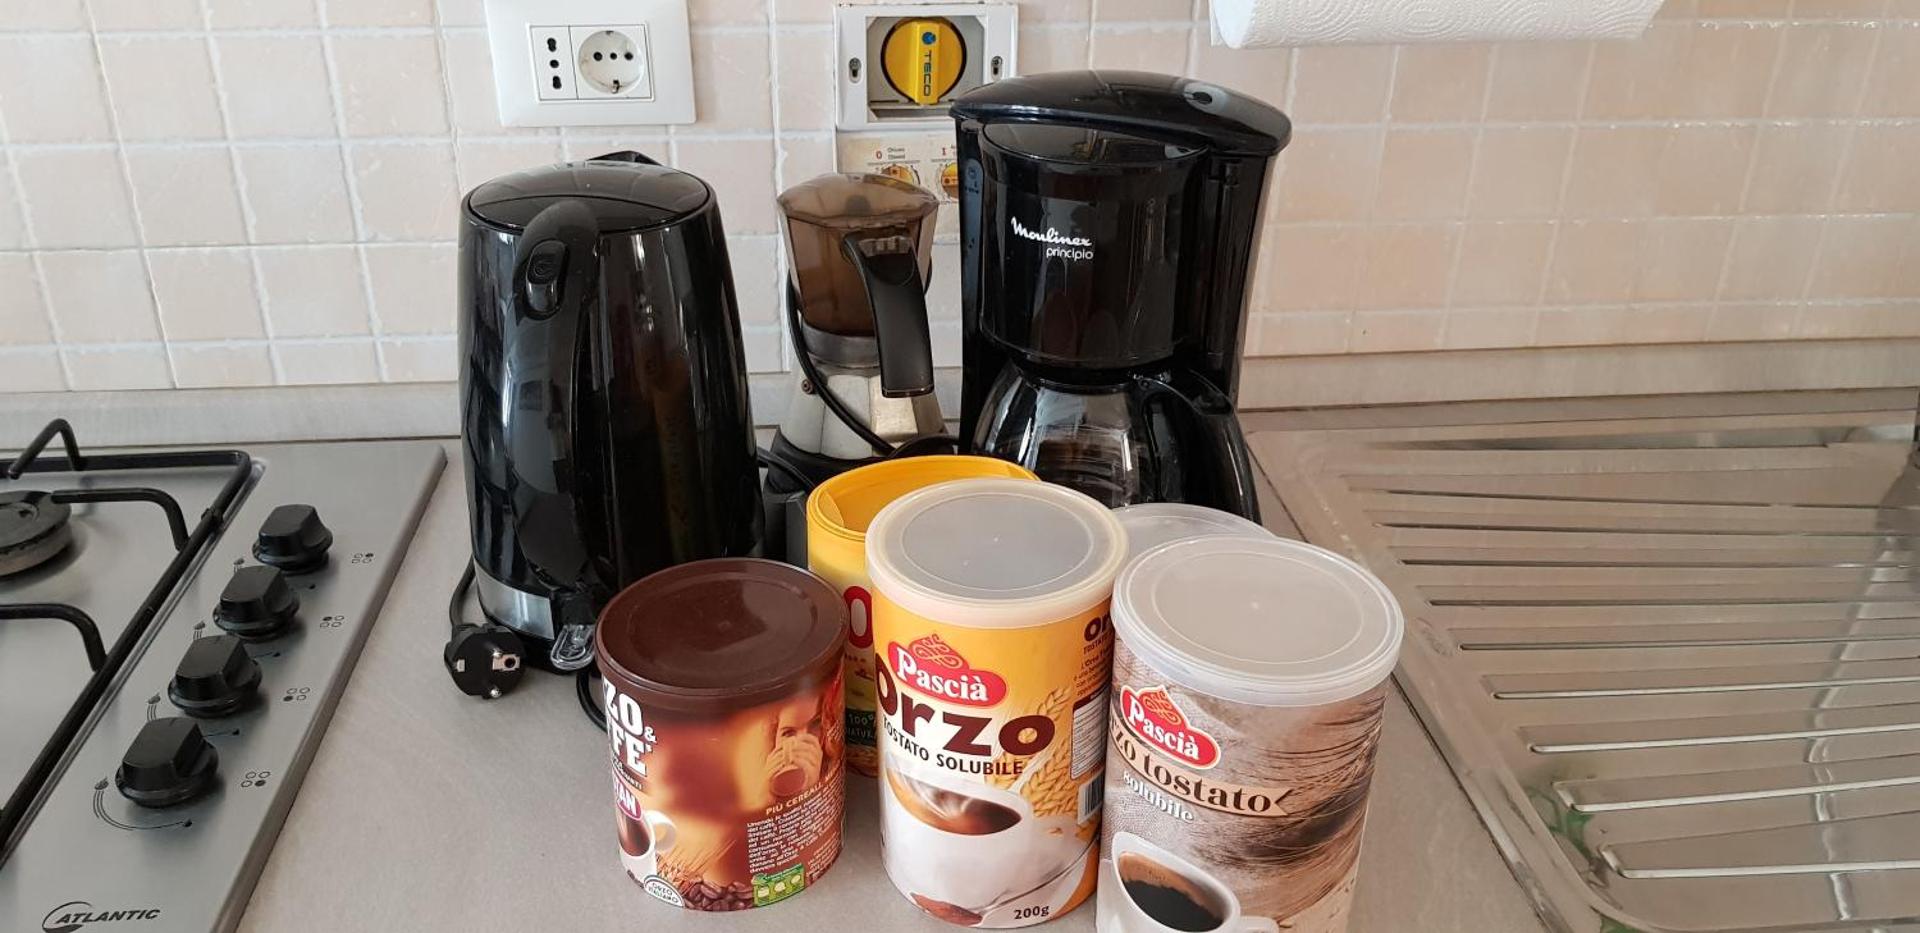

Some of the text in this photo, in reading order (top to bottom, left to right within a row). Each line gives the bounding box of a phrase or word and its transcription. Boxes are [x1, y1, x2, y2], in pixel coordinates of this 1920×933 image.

[923, 50, 932, 97] TECO
[1011, 216, 1092, 247] Moulinex
[1046, 247, 1094, 262] principio
[897, 647, 988, 702] Pascià
[602, 676, 644, 736] ZO
[875, 653, 1056, 757] Orzo
[1128, 696, 1199, 761] Pascià
[883, 716, 1024, 776] TOSTATO SOLUBILE
[1123, 770, 1195, 824] solubile
[1143, 753, 1272, 814] tostato
[55, 909, 161, 924] ATLANTIC
[1013, 905, 1050, 920] 200g
